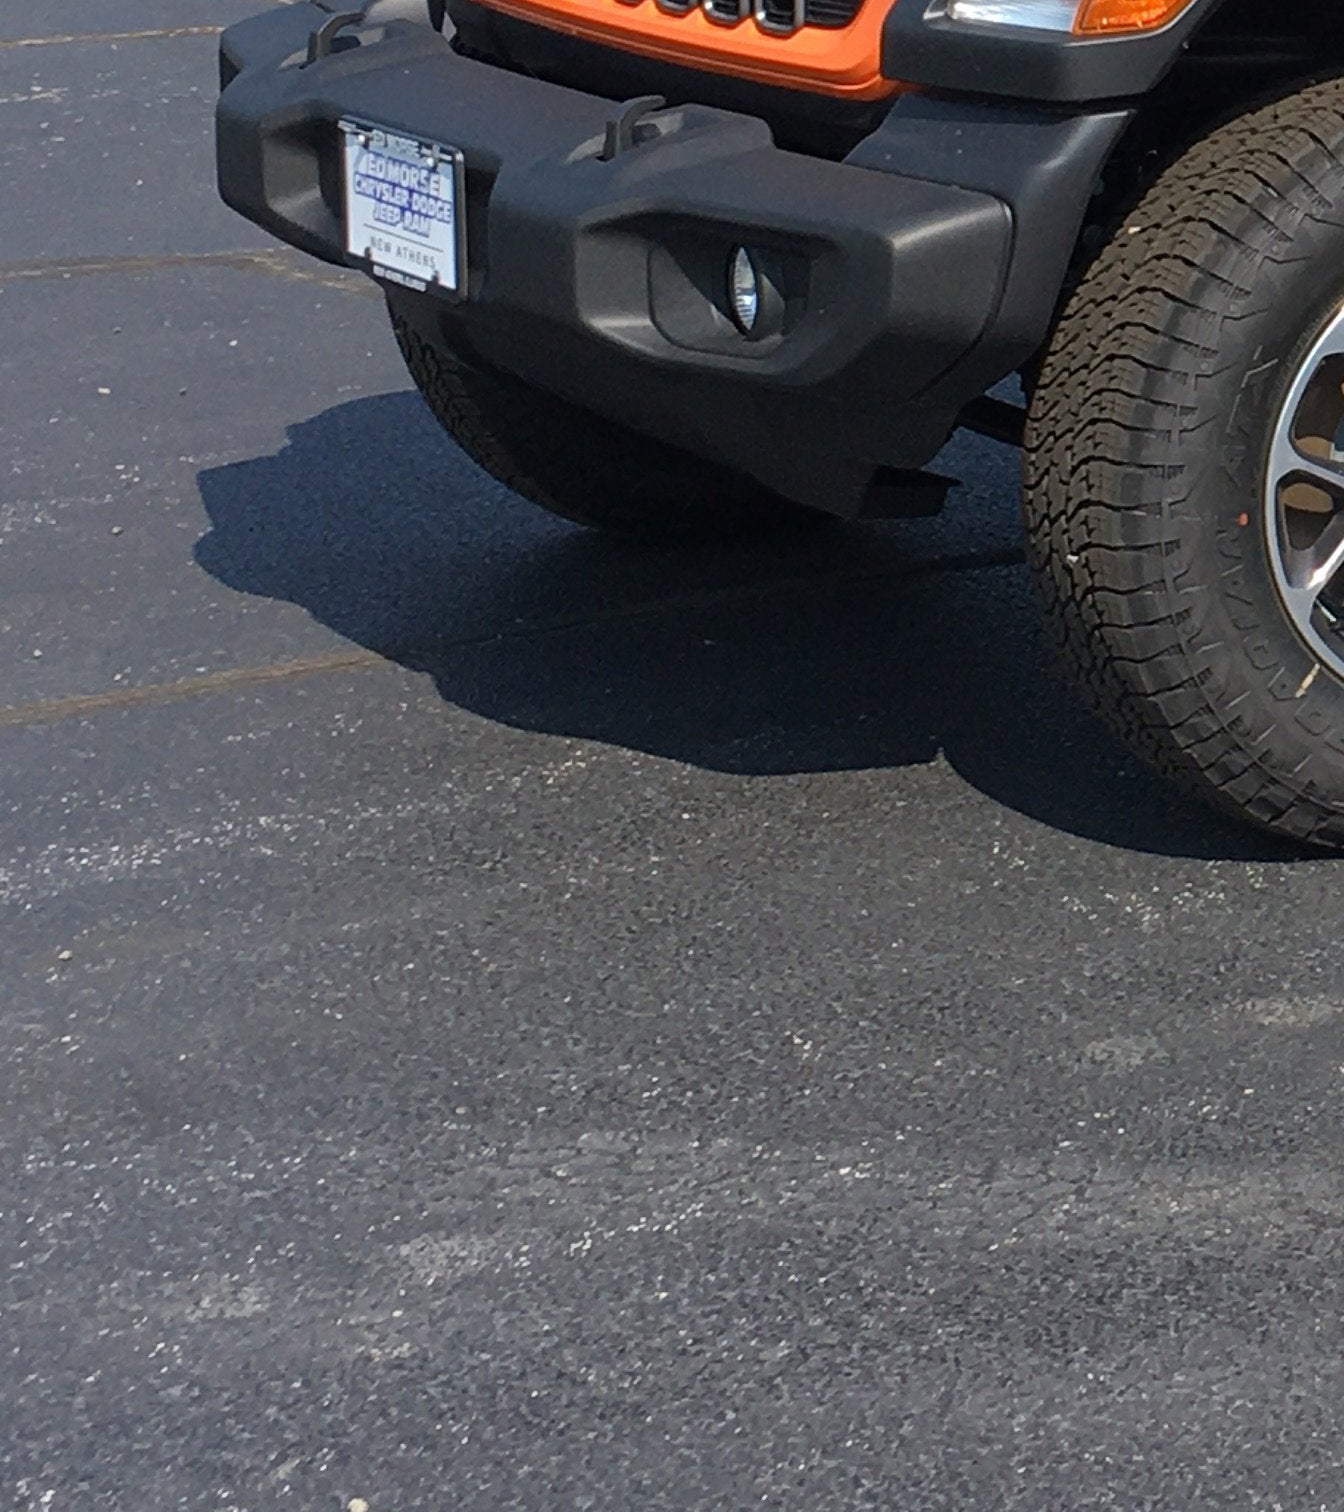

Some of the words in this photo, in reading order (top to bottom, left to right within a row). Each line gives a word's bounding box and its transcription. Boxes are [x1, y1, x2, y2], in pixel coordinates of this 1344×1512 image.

[367, 153, 385, 180] ED
[387, 156, 441, 197] MORSE
[354, 173, 410, 209] CHRYSLER
[411, 192, 452, 224] DODGE
[372, 201, 401, 226] JEEP
[402, 209, 431, 238] RAM
[370, 235, 392, 254] NEW
[395, 244, 437, 270] ATHENS
